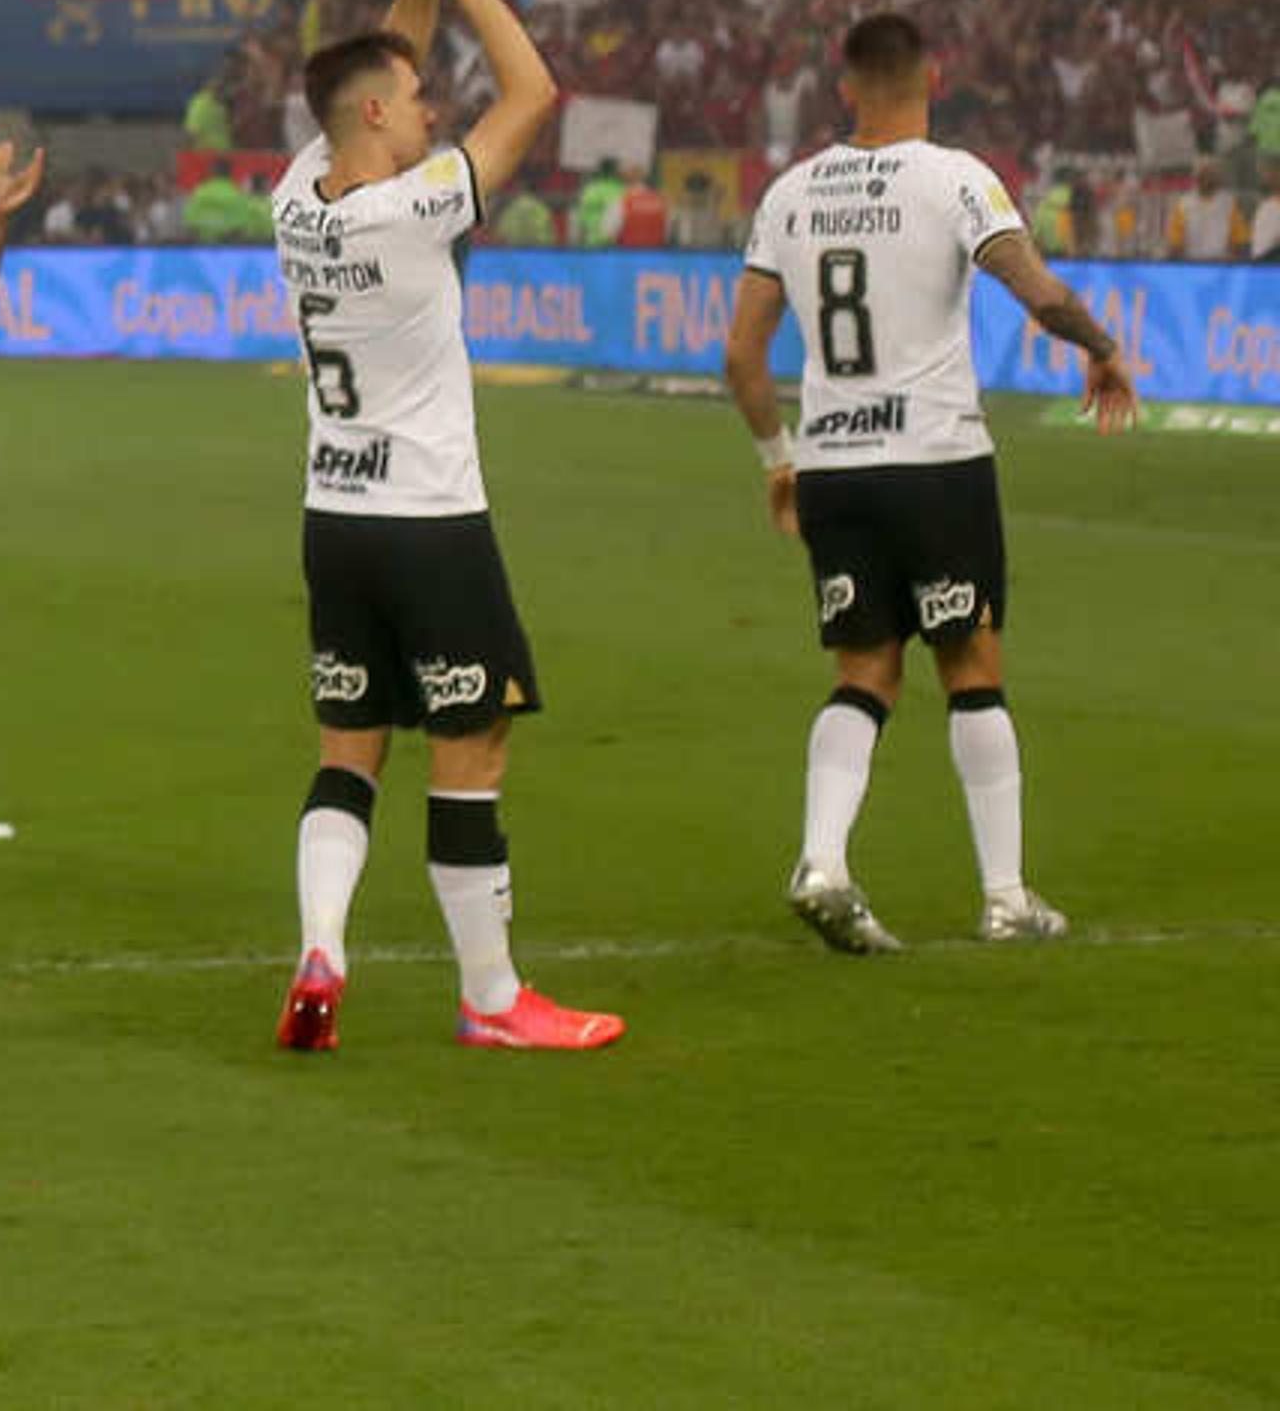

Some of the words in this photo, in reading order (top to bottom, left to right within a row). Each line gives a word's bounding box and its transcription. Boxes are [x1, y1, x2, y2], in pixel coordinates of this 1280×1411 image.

[811, 206, 900, 237] AUGUSTO
[323, 258, 384, 291] PITON
[113, 278, 216, 343] Copa
[466, 284, 594, 341] BRASIL
[635, 271, 744, 354] FINA
[819, 247, 876, 376] 8
[299, 292, 360, 419] 6
